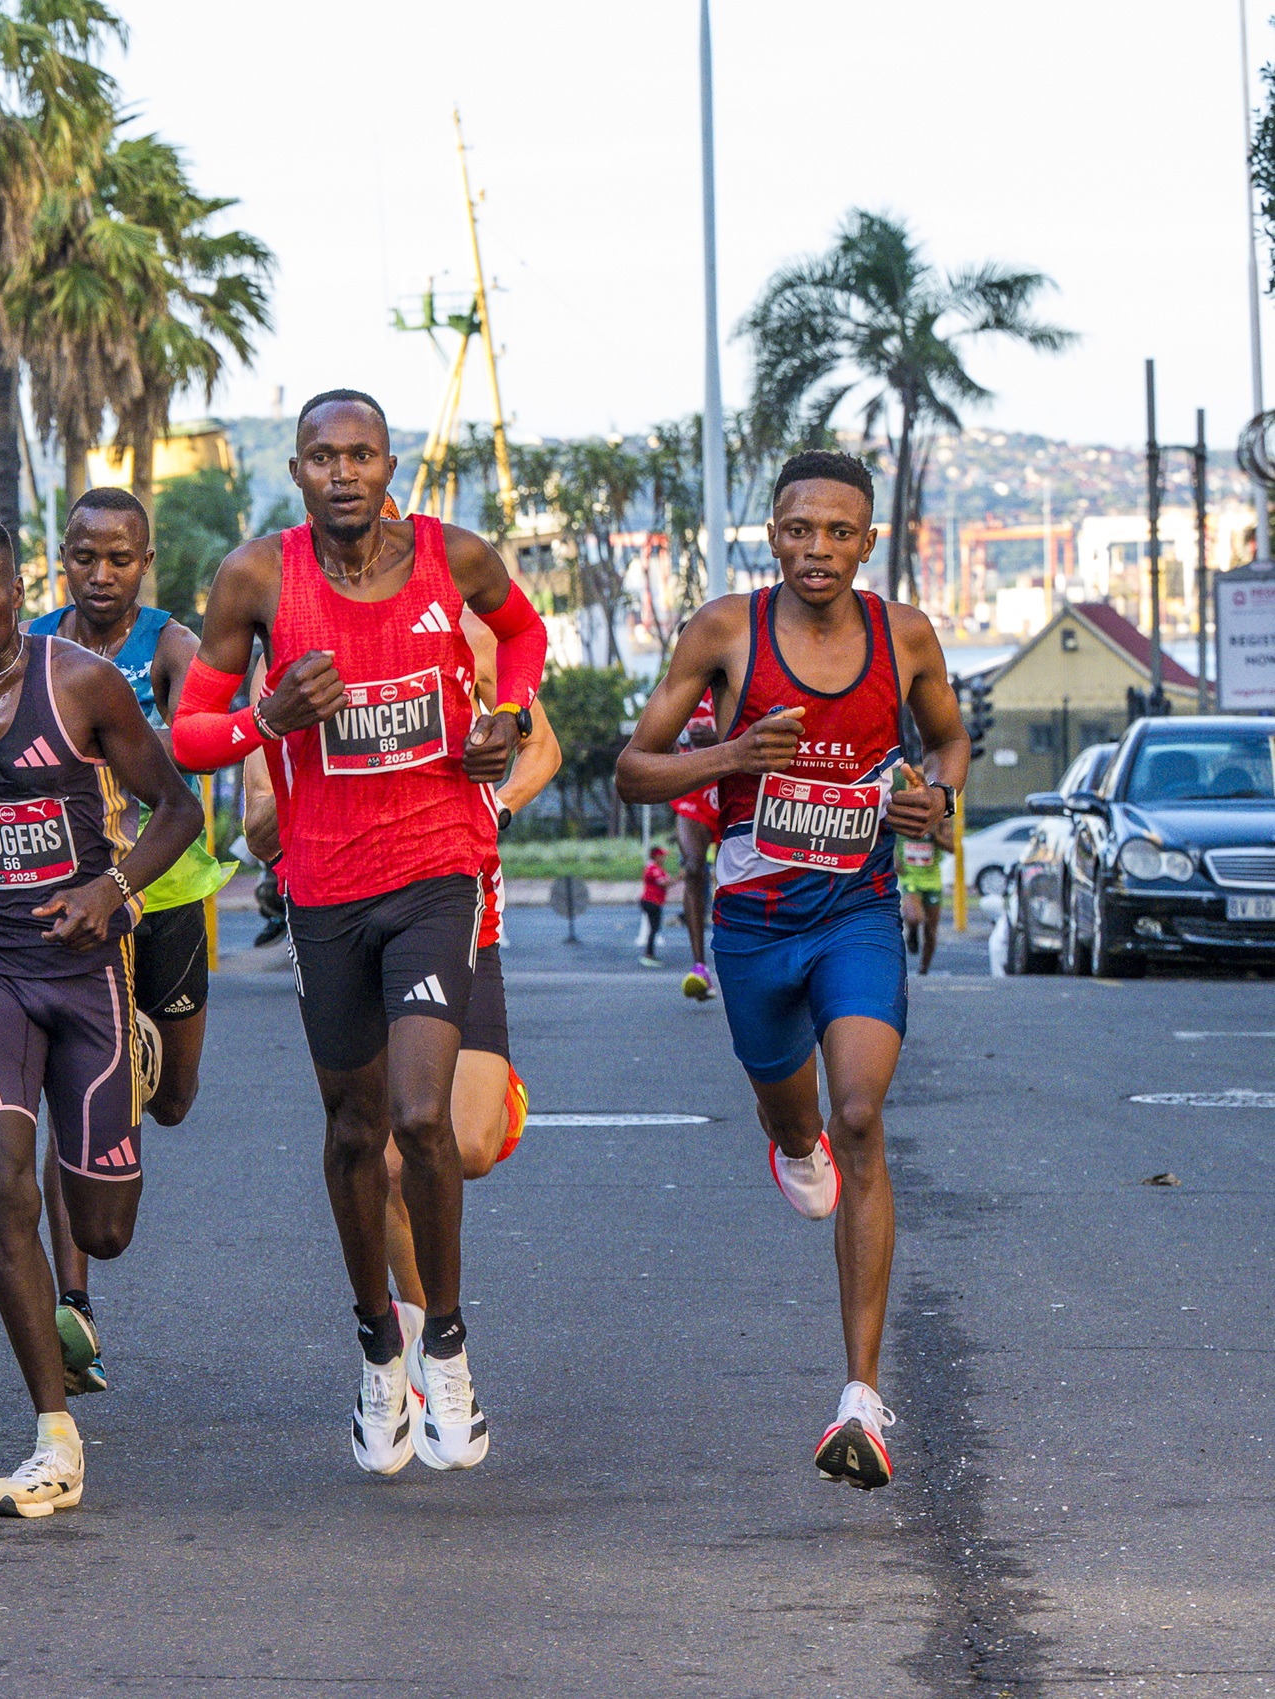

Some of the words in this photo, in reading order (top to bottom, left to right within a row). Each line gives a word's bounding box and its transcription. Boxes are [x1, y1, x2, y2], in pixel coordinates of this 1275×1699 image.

[335, 694, 431, 740] VINCENT
[379, 737, 398, 753] 69
[385, 751, 413, 765] 2025
[790, 760, 834, 768] RUNNING
[763, 796, 874, 840] KAMOHELO
[809, 837, 826, 852] 11
[3, 857, 21, 871] 56
[808, 854, 838, 866] 2025
[10, 872, 38, 882] 2025
[164, 1003, 195, 1013] adidas
